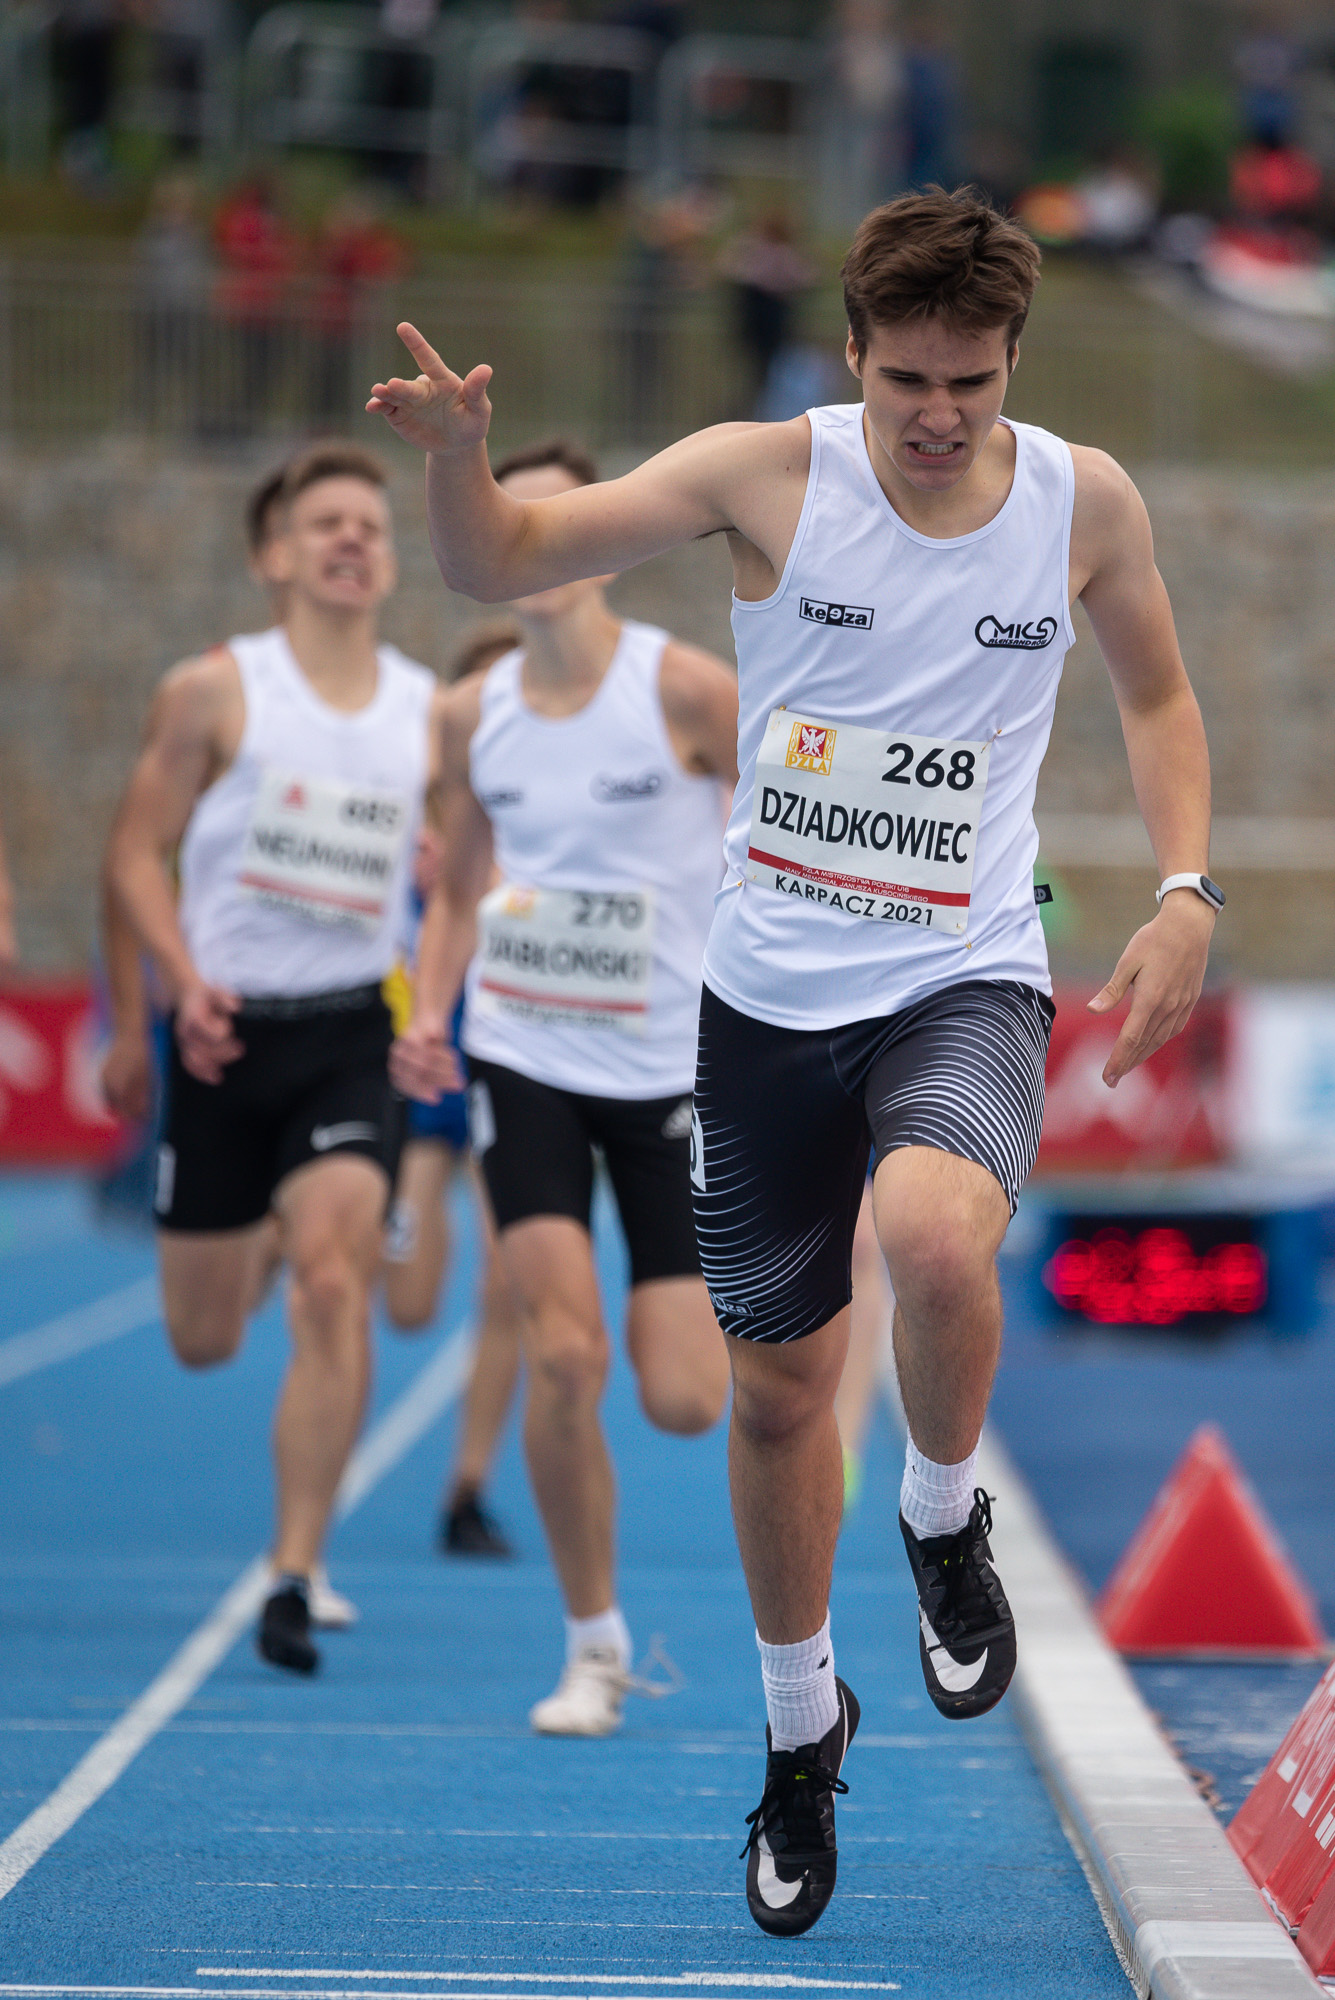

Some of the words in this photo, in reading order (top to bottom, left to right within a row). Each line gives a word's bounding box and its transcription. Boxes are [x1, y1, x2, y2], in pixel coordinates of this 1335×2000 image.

[788, 754, 828, 773] PZLA
[882, 743, 976, 791] 268
[760, 786, 972, 864] DZIADKOWIEC
[775, 874, 877, 918] KARPACZ
[881, 902, 934, 926] 2021
[820, 870, 871, 886] MISTRZOSTWA
[872, 880, 897, 891] POLSKI
[897, 885, 910, 893] U16
[840, 881, 873, 893] JANUSZA
[573, 891, 645, 928] 270
